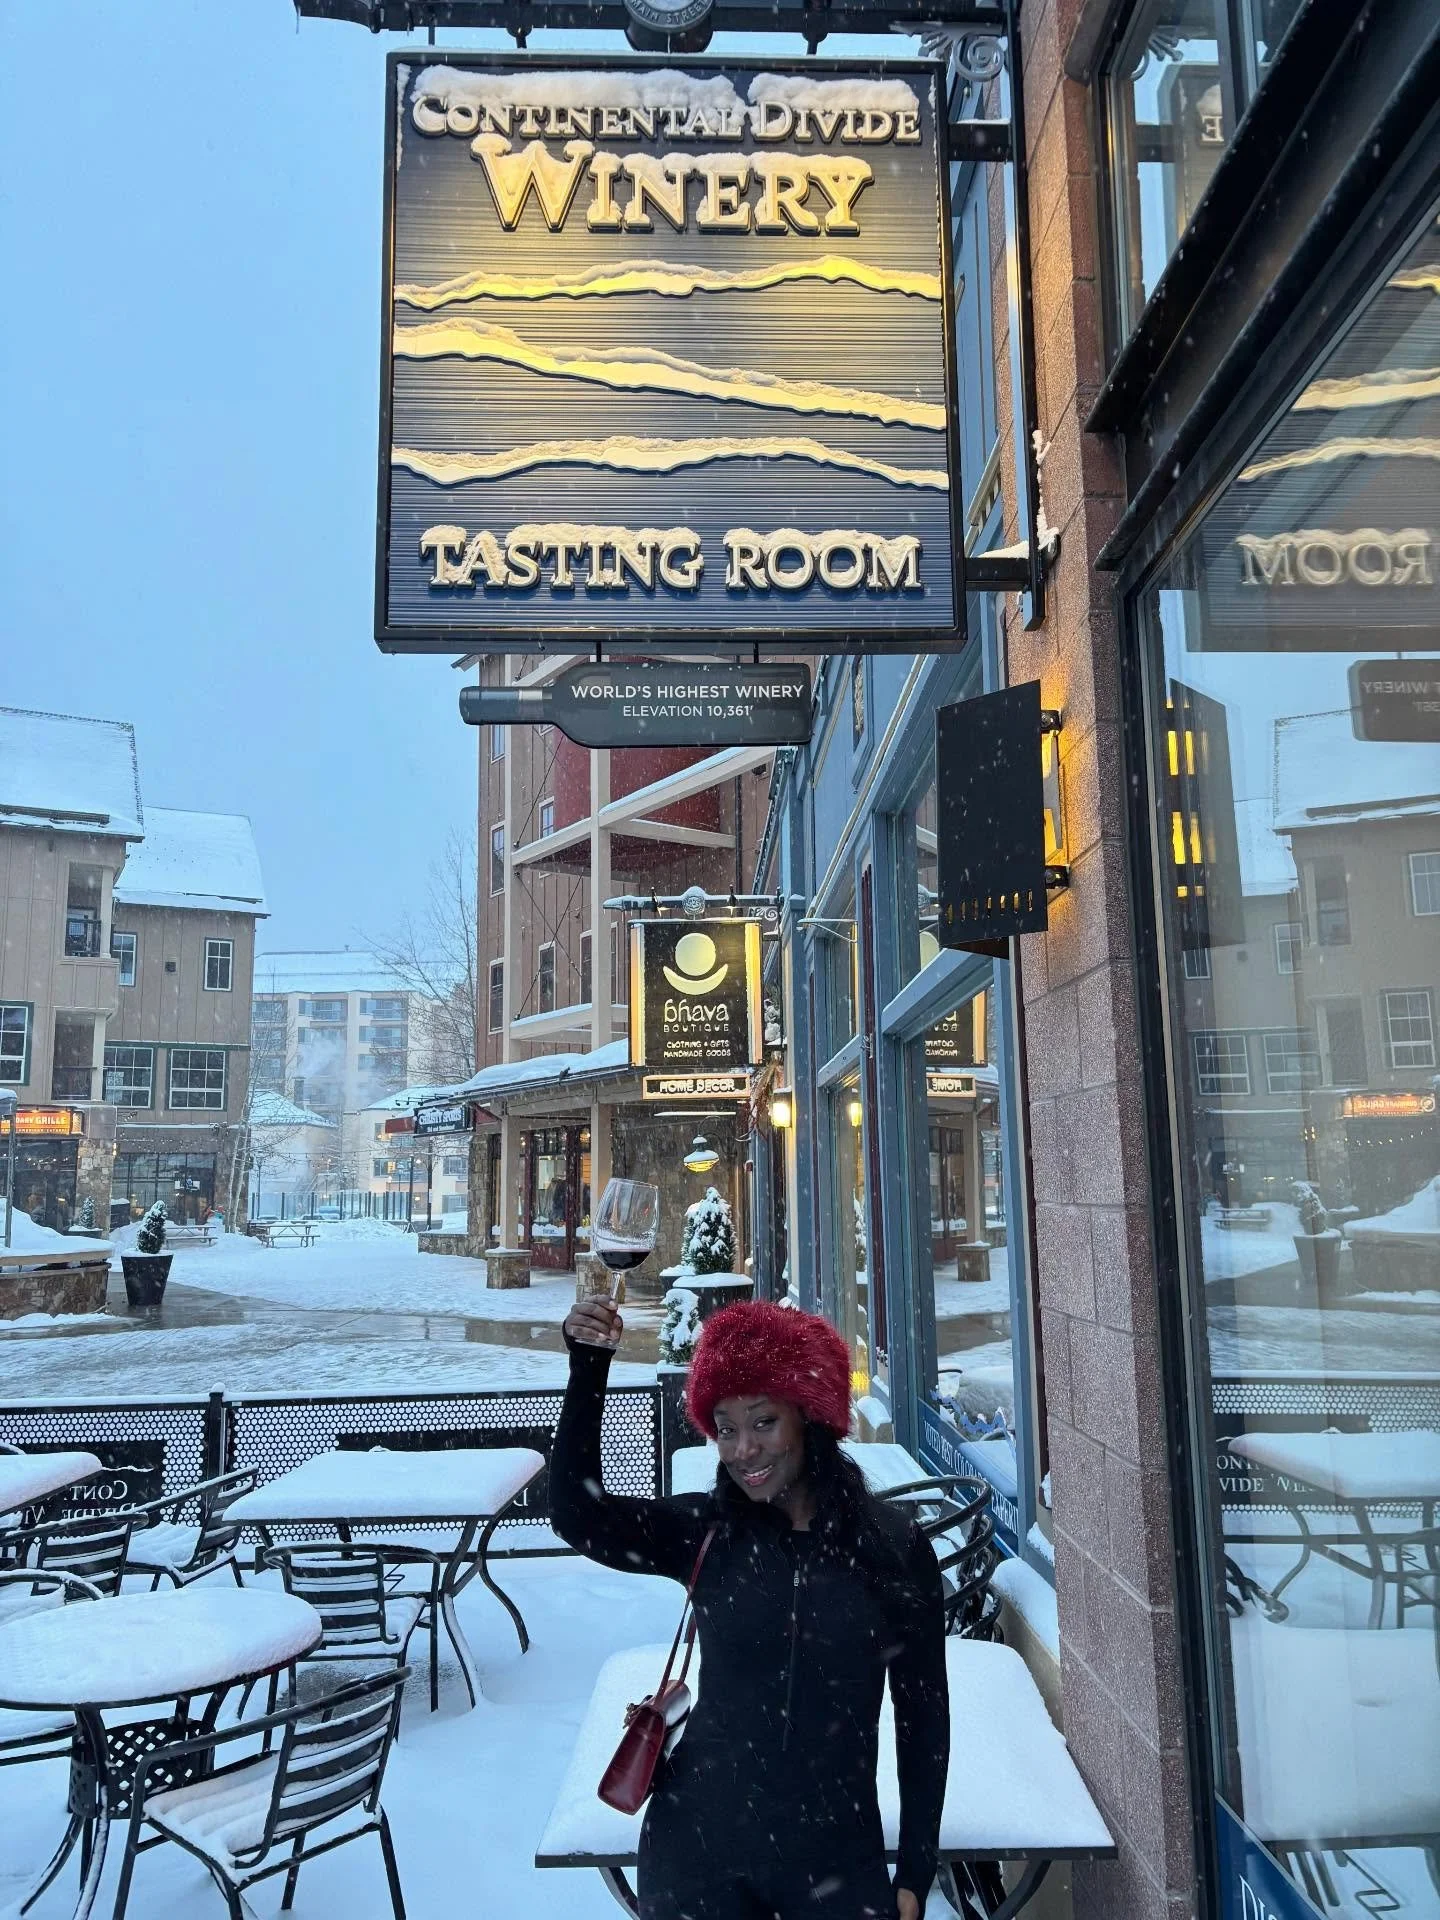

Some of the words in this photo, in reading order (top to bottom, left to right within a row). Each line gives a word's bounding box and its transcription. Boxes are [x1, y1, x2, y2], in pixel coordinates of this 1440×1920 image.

[412, 95, 743, 139] CONTINENTAL
[752, 100, 921, 143] DIVIDE
[470, 138, 875, 235] WINERY
[421, 534, 703, 590] TASTING
[726, 536, 923, 590] ROOM
[571, 685, 651, 699] WORLD'S
[657, 685, 729, 698] HIGHEST
[735, 685, 804, 698] WINERY
[623, 705, 702, 717] ELEVATION
[664, 999, 729, 1023] bhava
[664, 1023, 729, 1033] BOUTIQUE
[706, 1049, 732, 1058] GOODS
[660, 1079, 694, 1094] HOME
[697, 1078, 735, 1093] DECOR
[35, 1116, 66, 1124] GRILLE
